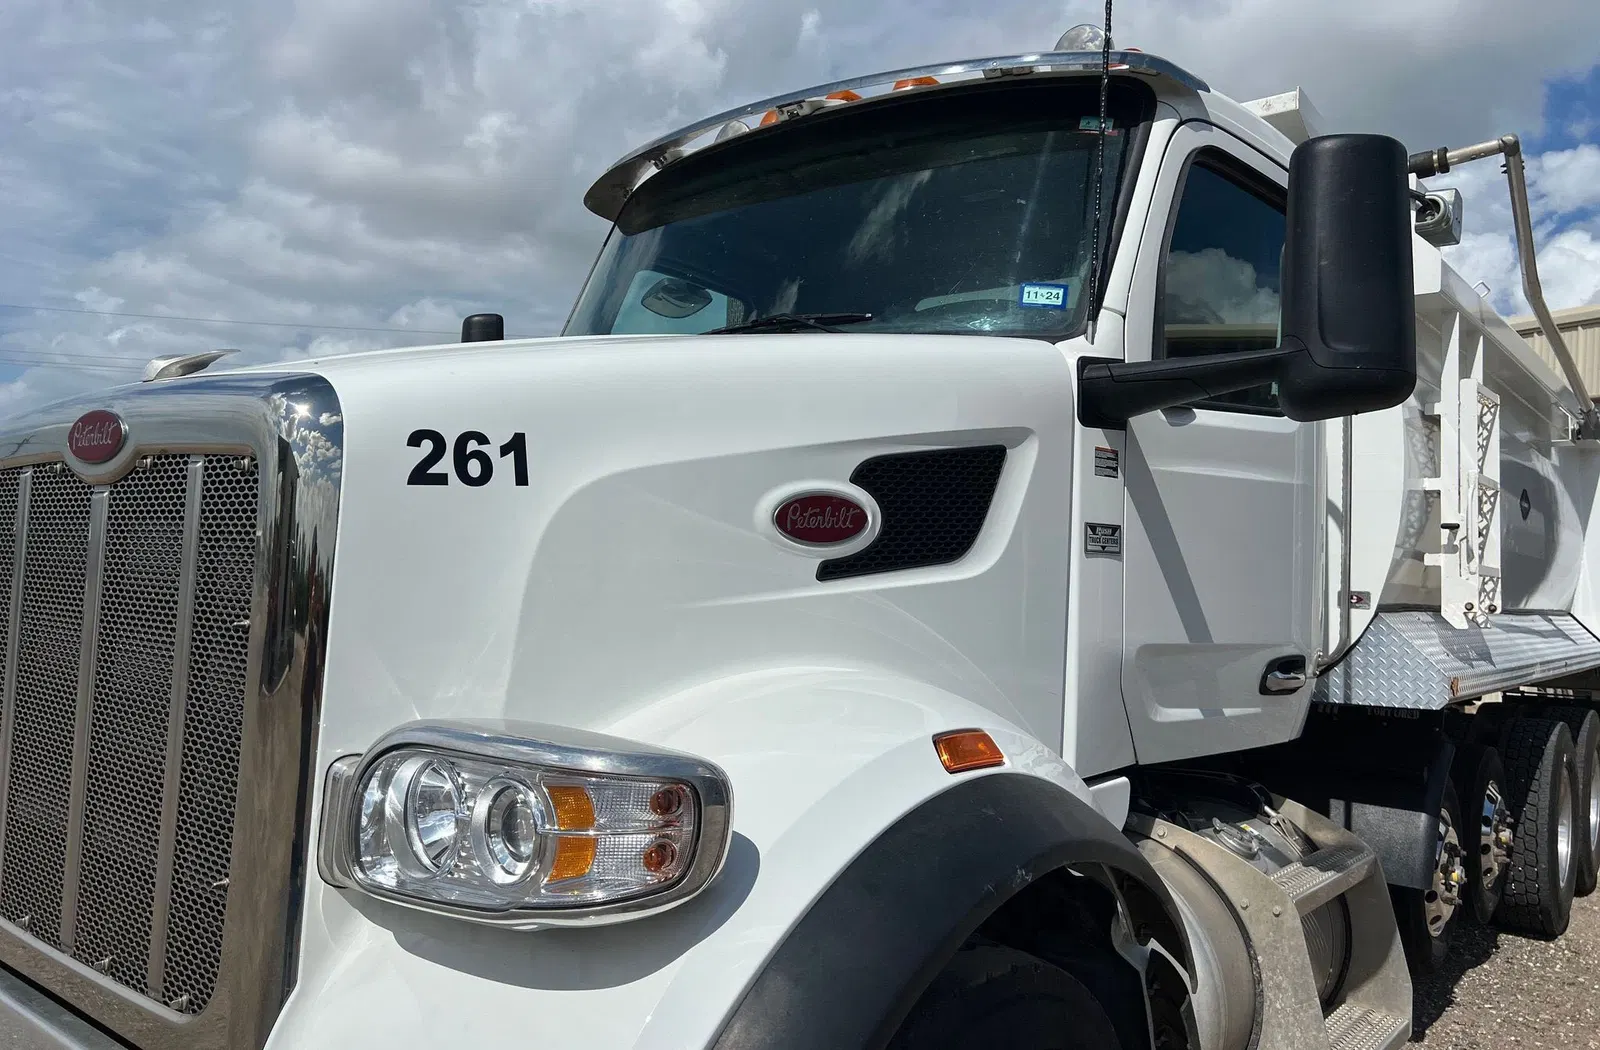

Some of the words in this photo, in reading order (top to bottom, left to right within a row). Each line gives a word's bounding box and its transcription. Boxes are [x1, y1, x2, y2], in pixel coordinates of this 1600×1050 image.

[73, 421, 118, 450] Peterbilt
[406, 429, 529, 487] 261
[787, 503, 860, 531] Peterbilt
